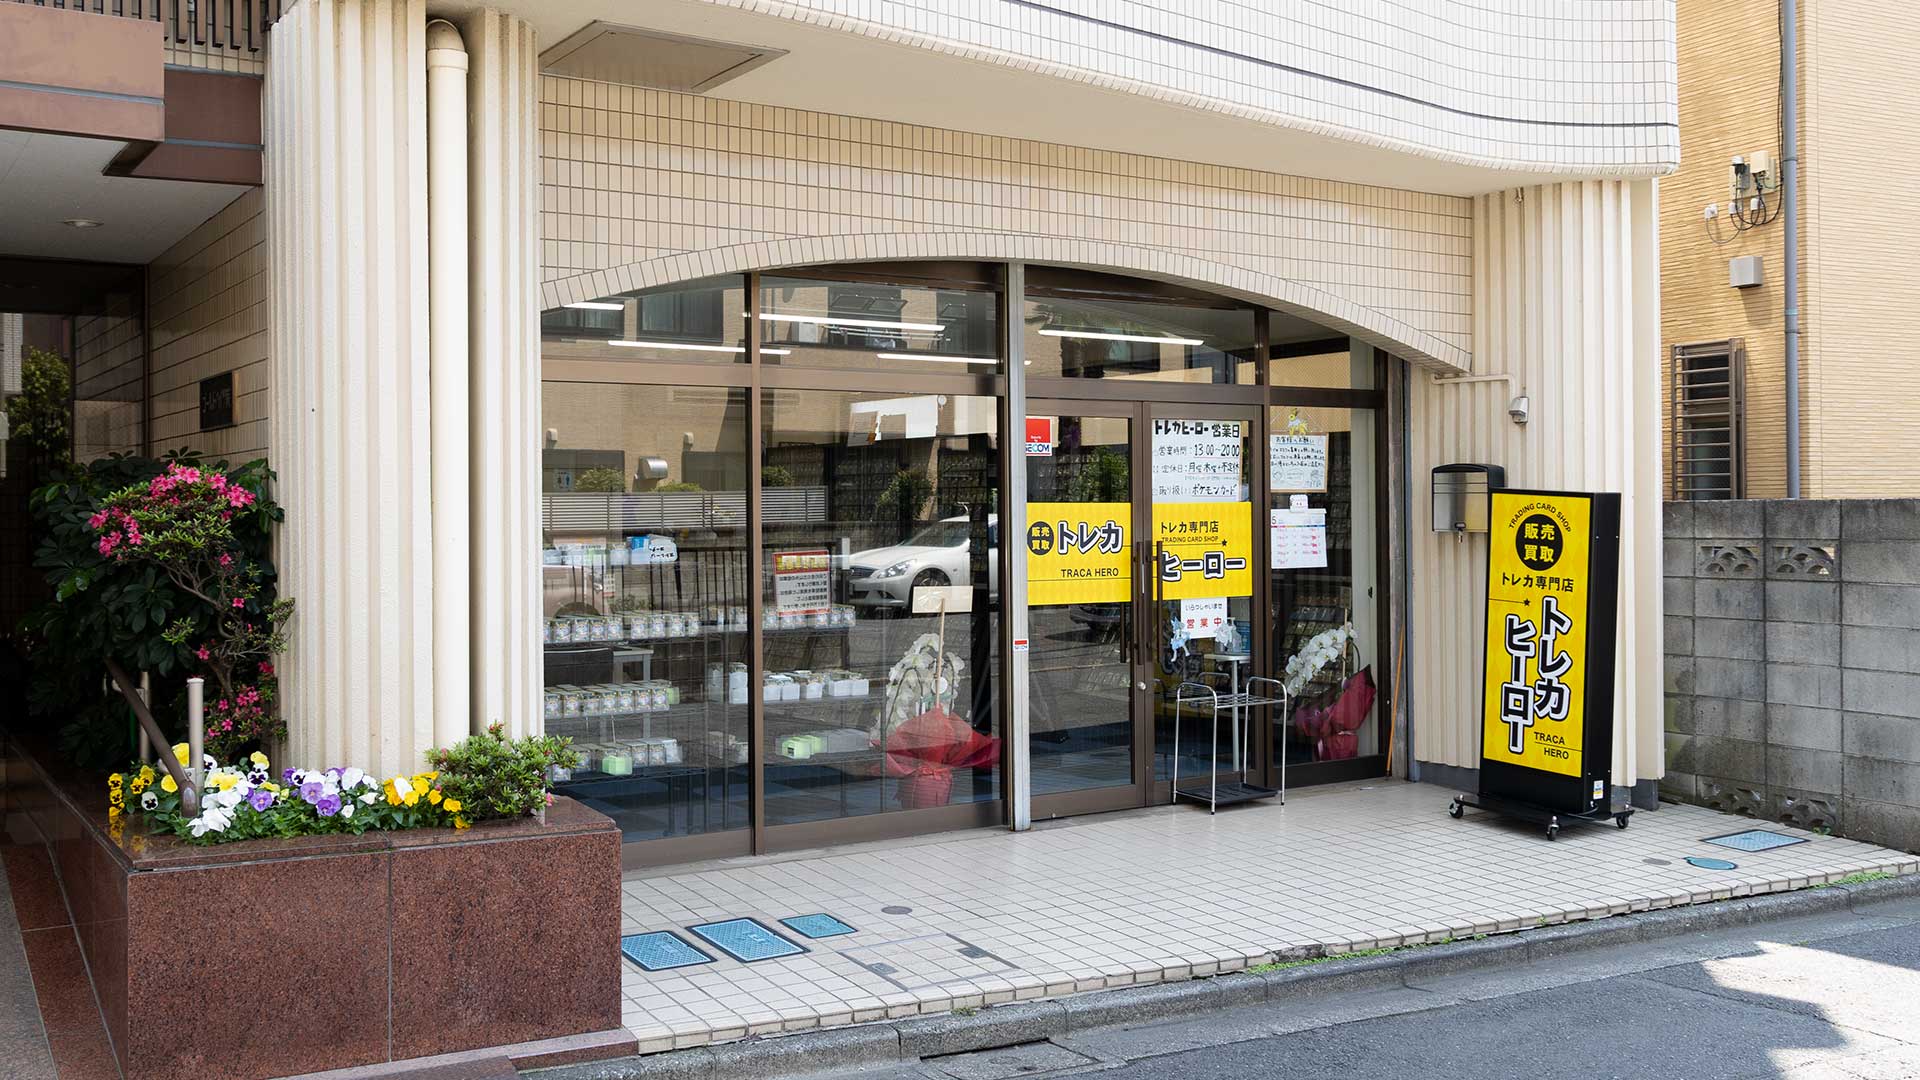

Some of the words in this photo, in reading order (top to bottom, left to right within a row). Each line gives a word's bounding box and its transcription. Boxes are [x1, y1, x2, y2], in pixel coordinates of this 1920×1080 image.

[1155, 420, 1209, 435] トレカヒーロー
[1211, 423, 1240, 438] 営業日
[1508, 503, 1535, 529] TRADING
[1535, 502, 1557, 514] CARD
[1556, 511, 1572, 532] SHOP
[1031, 526, 1050, 537] 販売
[1161, 520, 1219, 534] トレカ専門店
[1524, 522, 1555, 541] 販売
[1031, 539, 1050, 551] 買取
[1058, 520, 1123, 555] トレカ
[1524, 544, 1555, 563] 買取
[1061, 568, 1092, 578] TRACA
[1094, 567, 1119, 577] HERO
[1161, 550, 1247, 582] ヒーロー
[1502, 572, 1574, 593] トレカ専門店
[1186, 616, 1222, 630] 営業中
[1533, 596, 1573, 722] トレカ
[1500, 613, 1537, 755] ヒーロー
[1533, 731, 1566, 745] TRACA
[1543, 747, 1569, 760] HERO
